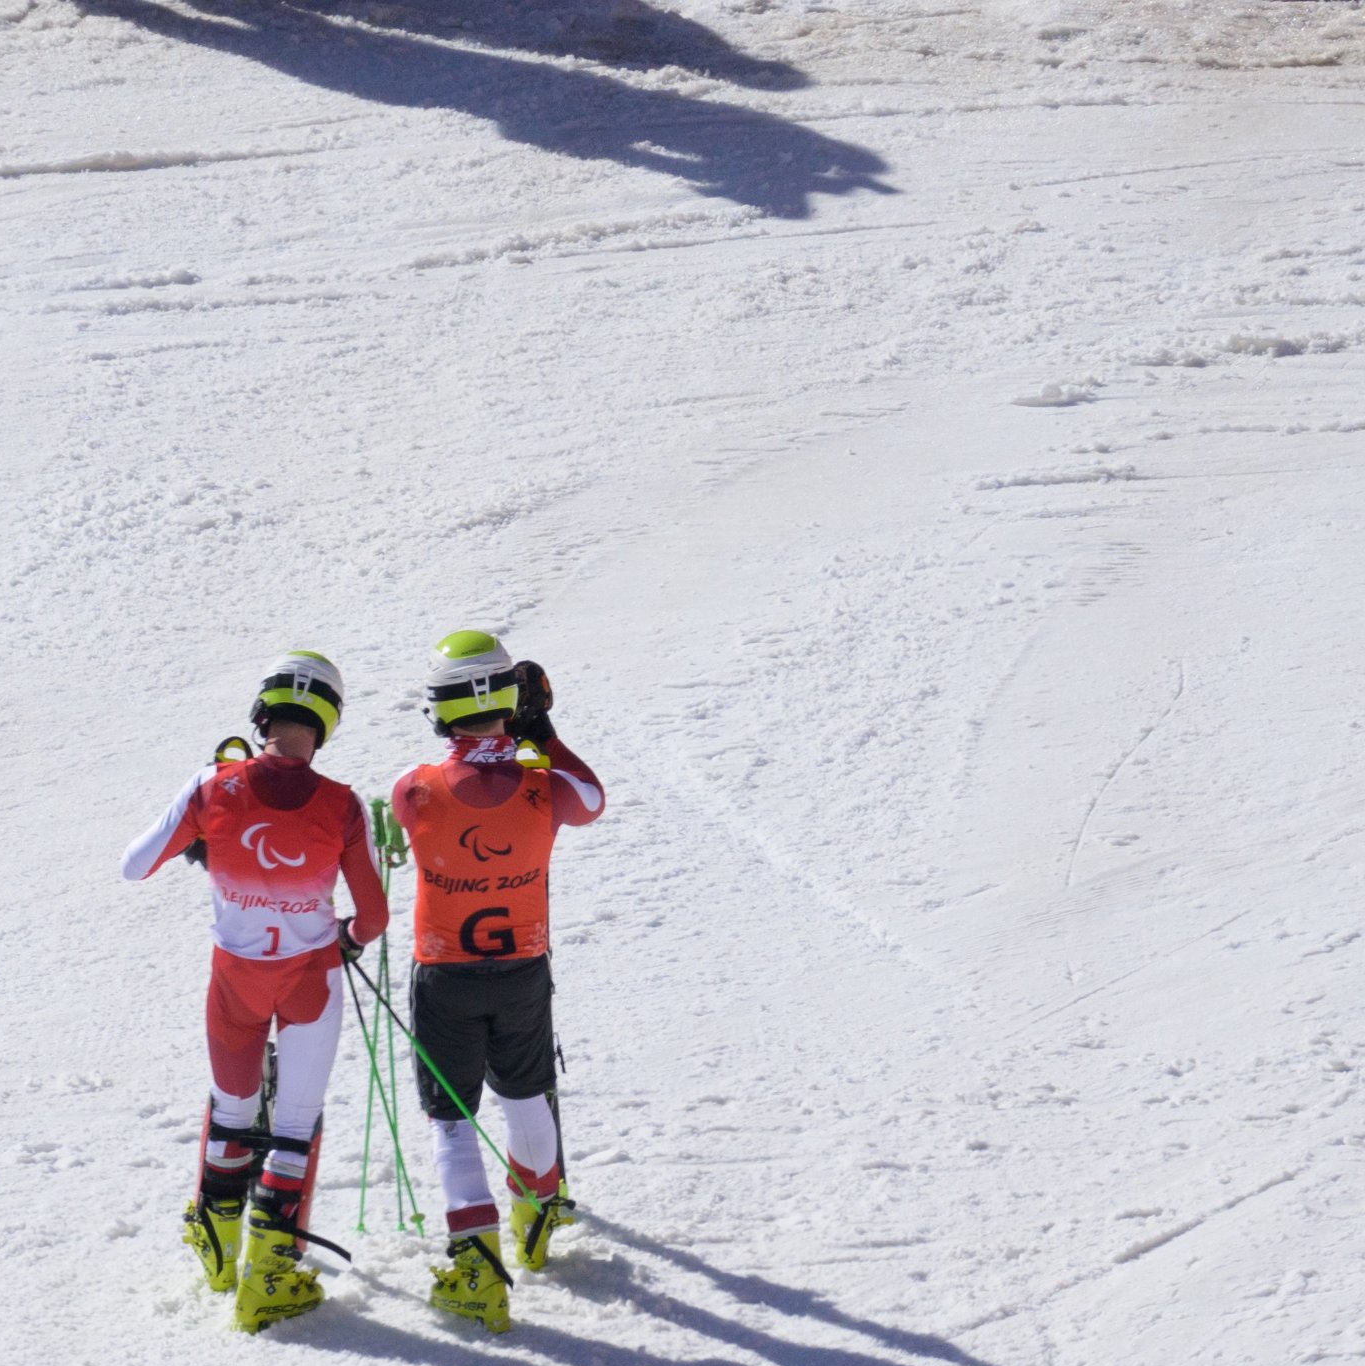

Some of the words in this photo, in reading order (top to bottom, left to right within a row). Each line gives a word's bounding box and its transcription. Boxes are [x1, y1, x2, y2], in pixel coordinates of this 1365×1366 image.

[423, 867, 490, 895] BEIJING
[496, 868, 540, 890] 2022
[261, 926, 280, 957] 1
[459, 906, 517, 958] G
